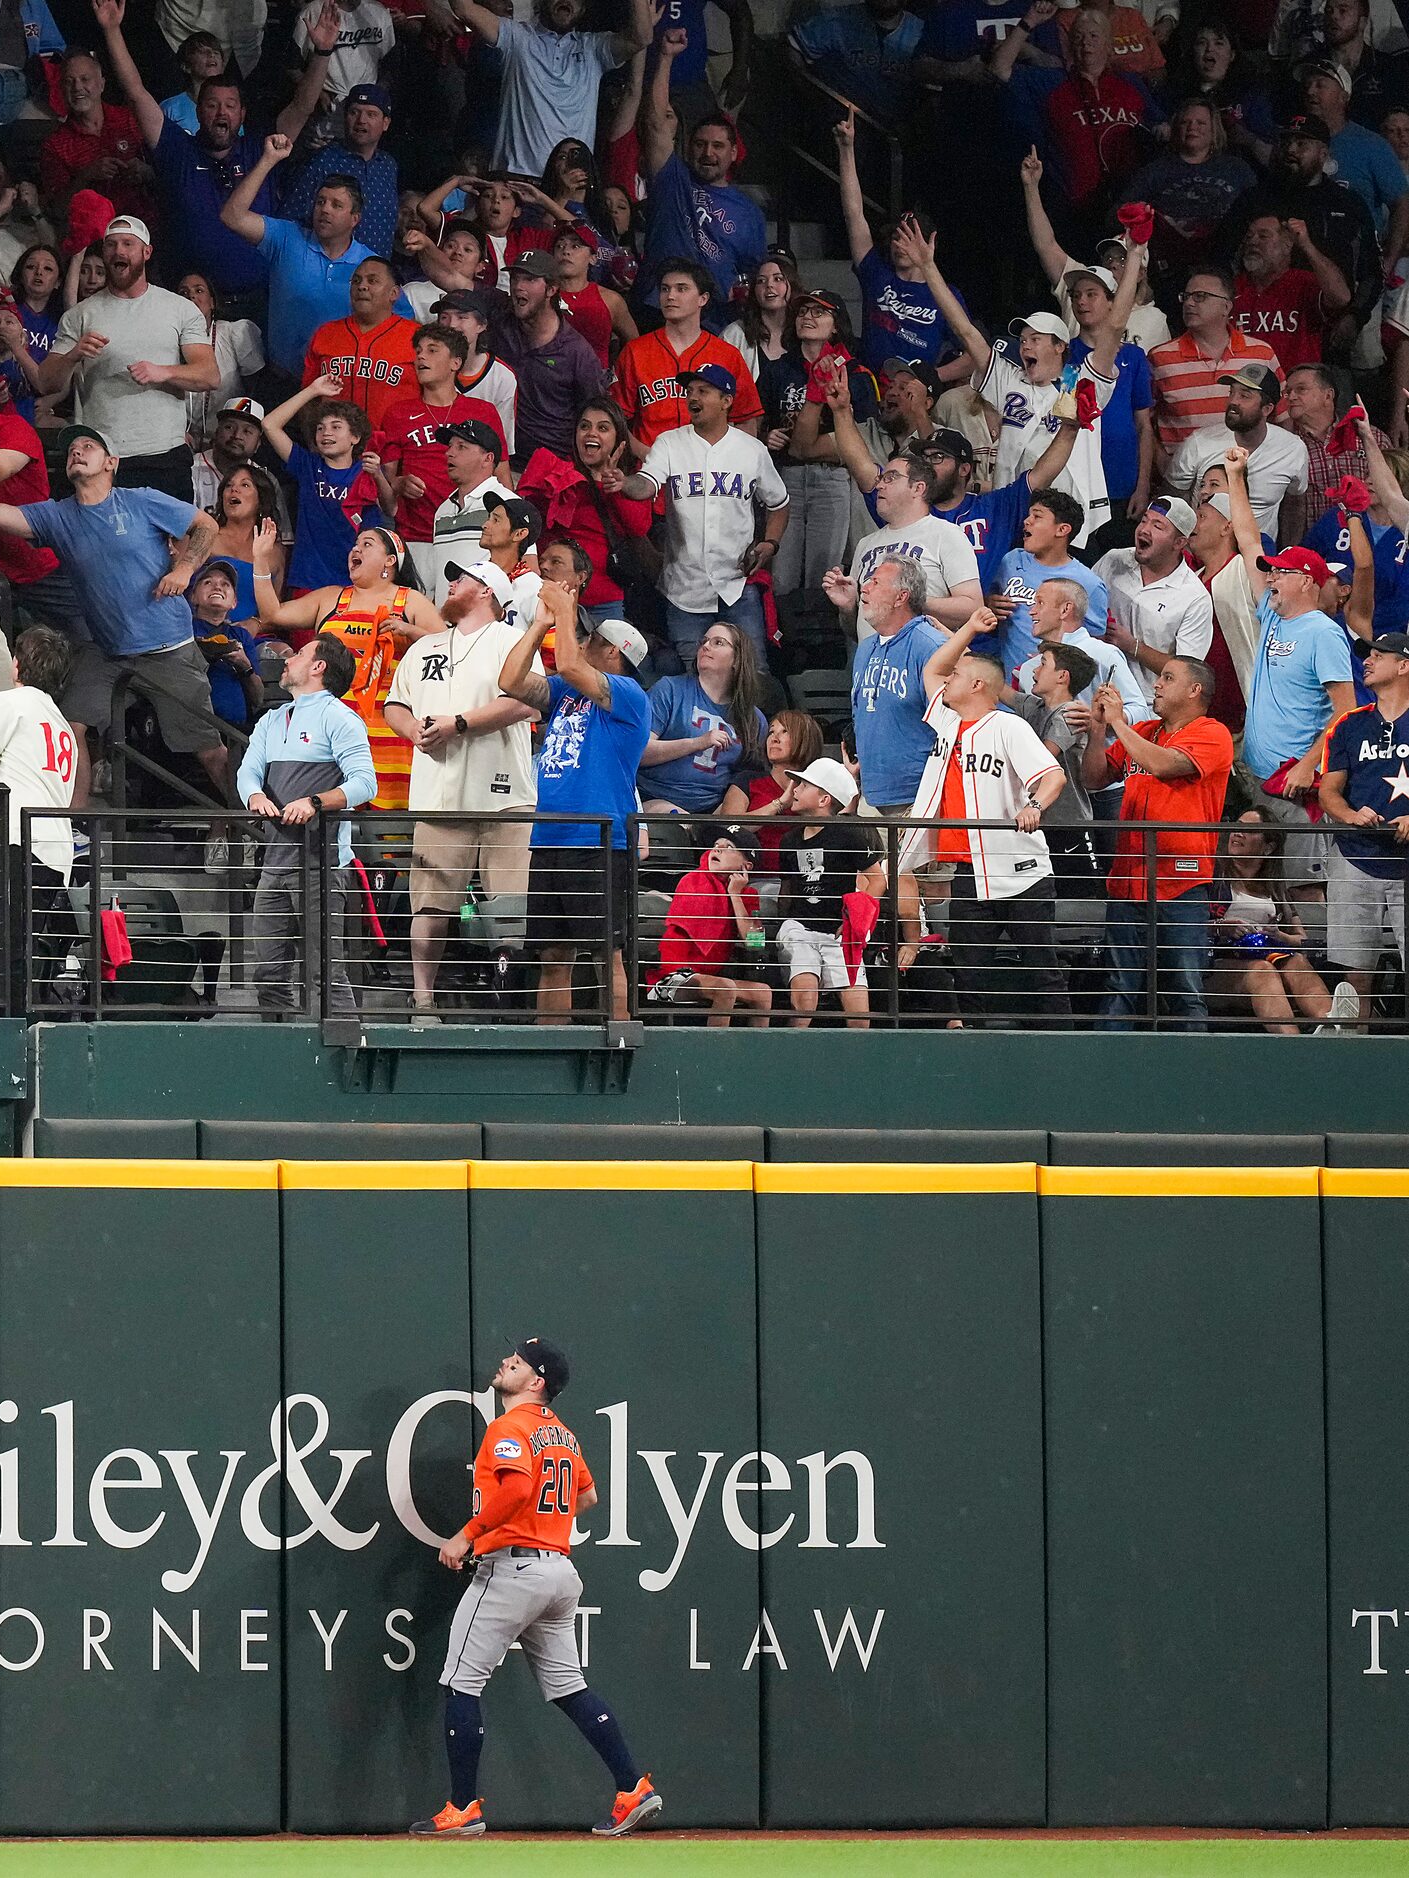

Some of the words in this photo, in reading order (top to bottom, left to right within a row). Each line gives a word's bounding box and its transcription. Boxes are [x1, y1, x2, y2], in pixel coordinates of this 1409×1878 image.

[335, 27, 384, 49] angers
[1073, 106, 1139, 127] TEXAS
[877, 285, 938, 325] Rangers
[1228, 310, 1300, 334] EXAS
[321, 355, 404, 387] ASTROS
[669, 471, 758, 501] TEXAS
[960, 518, 989, 553] T
[1335, 528, 1351, 552] 8
[38, 721, 74, 783] 18
[494, 1446, 522, 1455] OXY
[537, 1457, 574, 1515] 20
[690, 1607, 886, 1672] LAW
[1352, 1608, 1409, 1674] T
